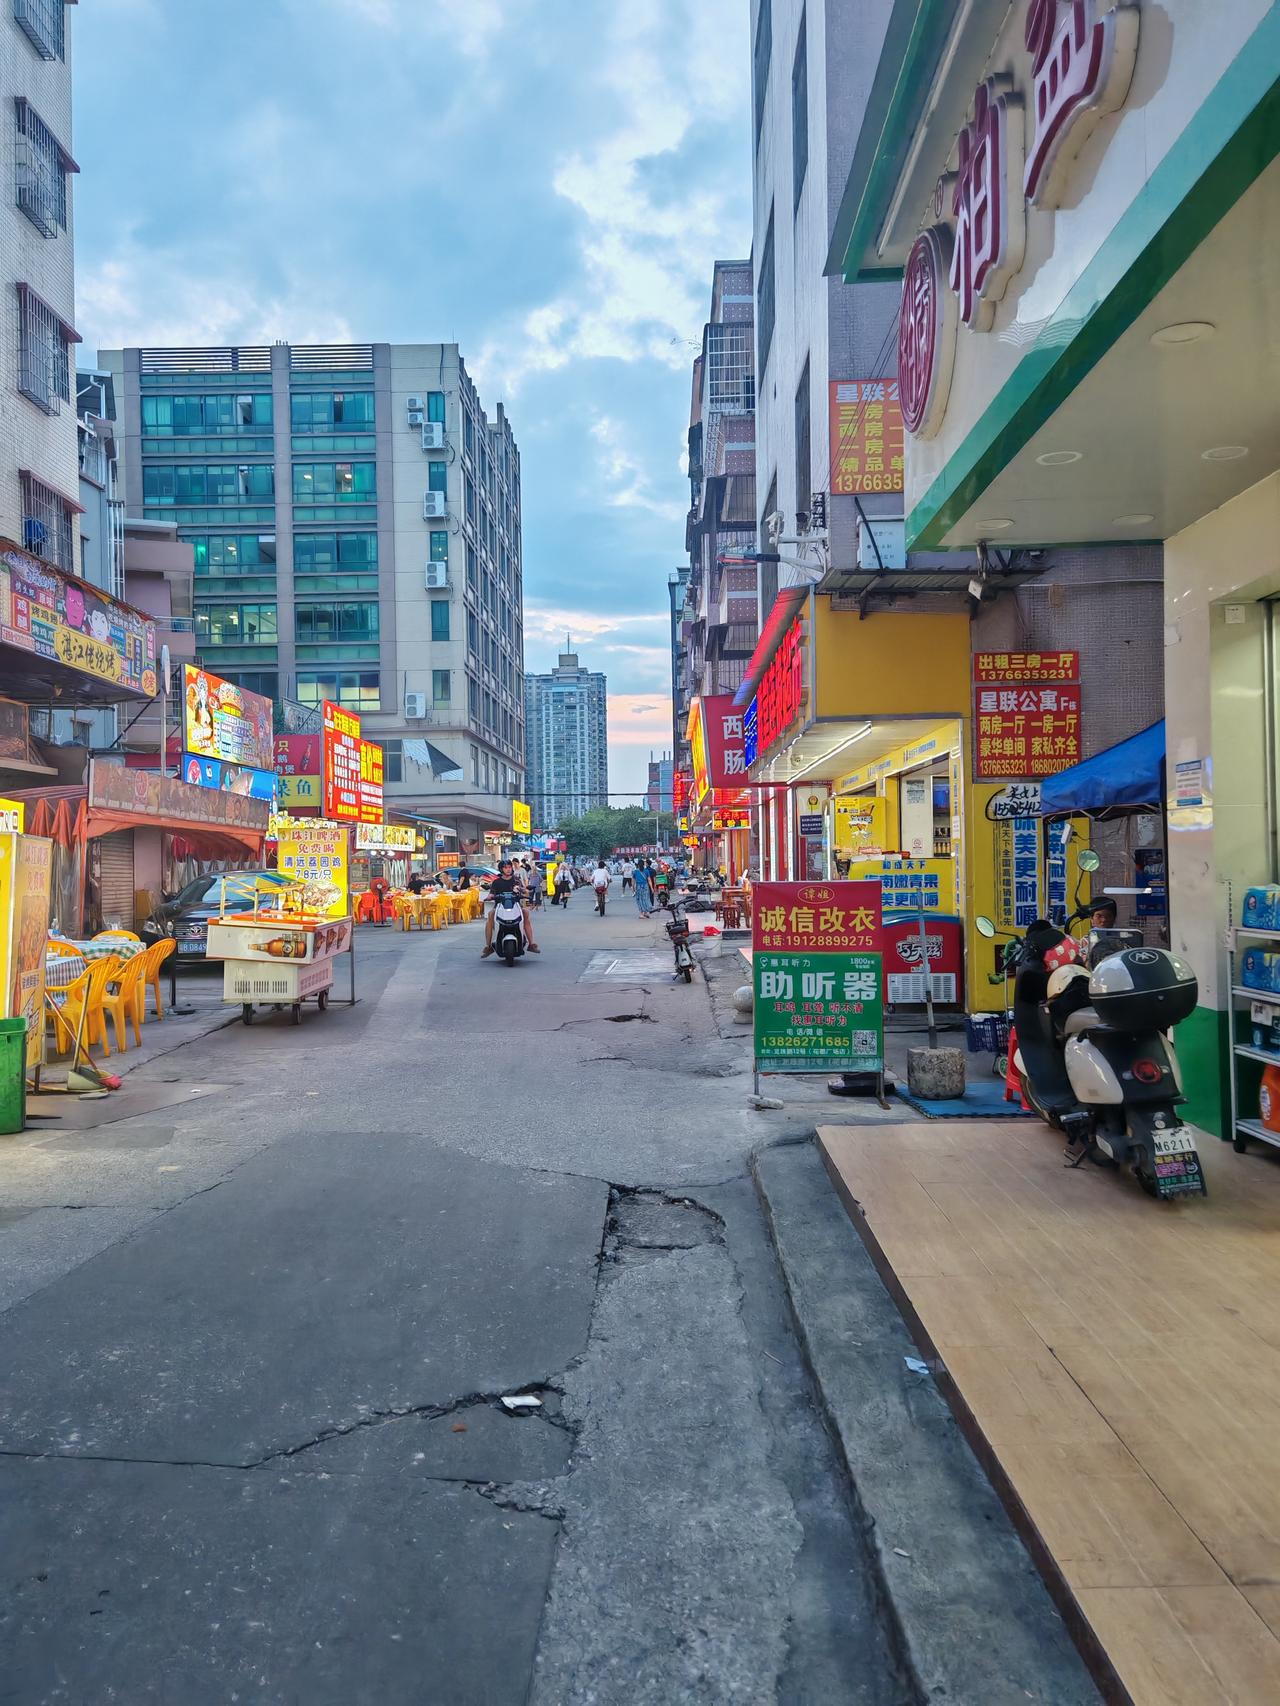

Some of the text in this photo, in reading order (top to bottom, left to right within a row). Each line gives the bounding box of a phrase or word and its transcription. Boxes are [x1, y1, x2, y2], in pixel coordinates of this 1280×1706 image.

[839, 439, 904, 454] 一房一
[836, 473, 902, 491] 1376635
[979, 654, 1072, 669] 出租三房一厅
[980, 669, 1072, 681] 13766353231
[979, 690, 1057, 712] 星联公寓
[979, 713, 1077, 735] 两房一厅 一房一厅
[979, 736, 1078, 757] 豪华单间 家私齐全
[979, 759, 1026, 775] 13766353231
[866, 874, 938, 888] 南嫩青果
[759, 906, 876, 933] 诚信改衣
[760, 971, 877, 1000] 助听器
[761, 1037, 849, 1047] 13826271685
[1154, 1138, 1192, 1153] M6211
